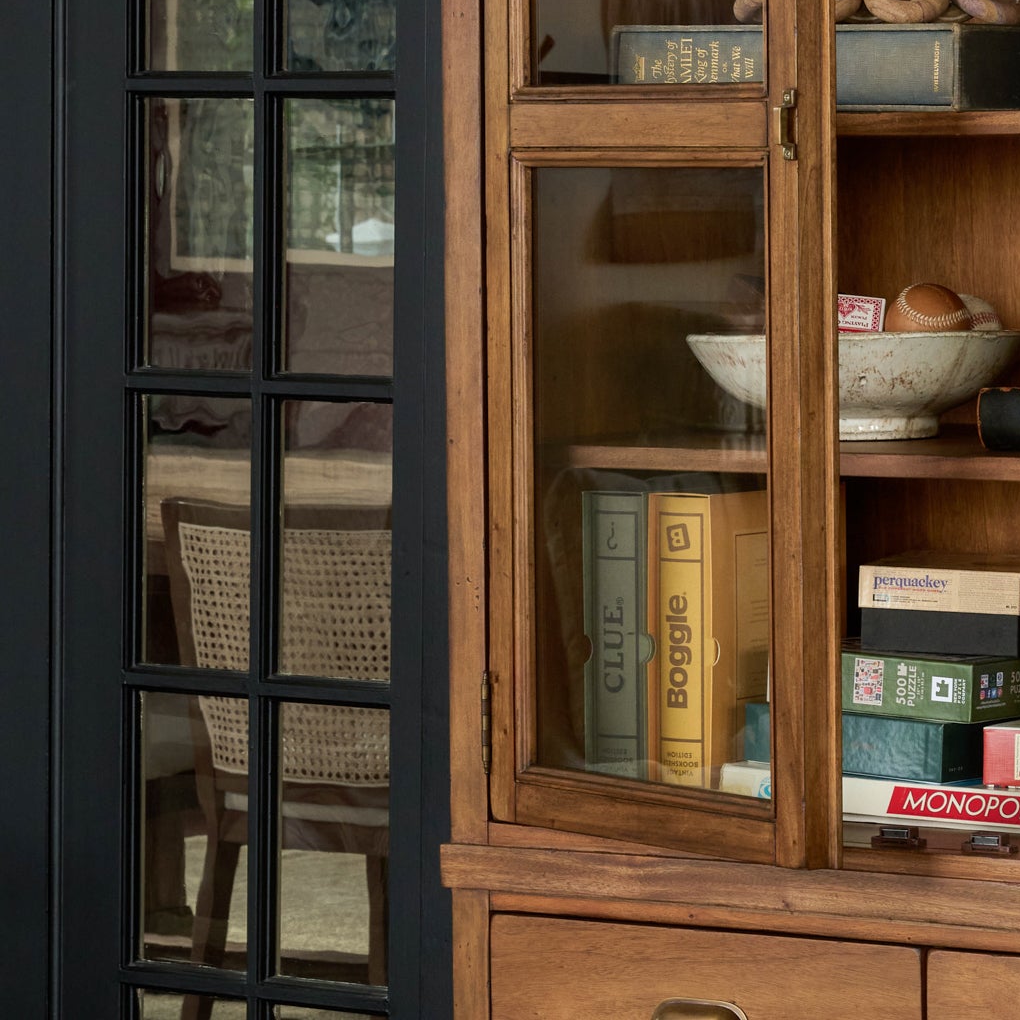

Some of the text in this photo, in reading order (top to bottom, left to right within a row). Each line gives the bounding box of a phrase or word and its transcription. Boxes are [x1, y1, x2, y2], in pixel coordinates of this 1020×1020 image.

[664, 39, 679, 84] ystery of
[695, 47, 708, 59] of
[709, 40, 720, 84] enmark
[731, 45, 741, 60] We
[651, 59, 662, 79] The
[744, 57, 754, 79] Will
[873, 574, 949, 594] perquackey
[603, 604, 625, 694] CLUE
[665, 594, 693, 709] Boggle
[895, 677, 908, 706] 500
[907, 665, 917, 707] PUZZLE
